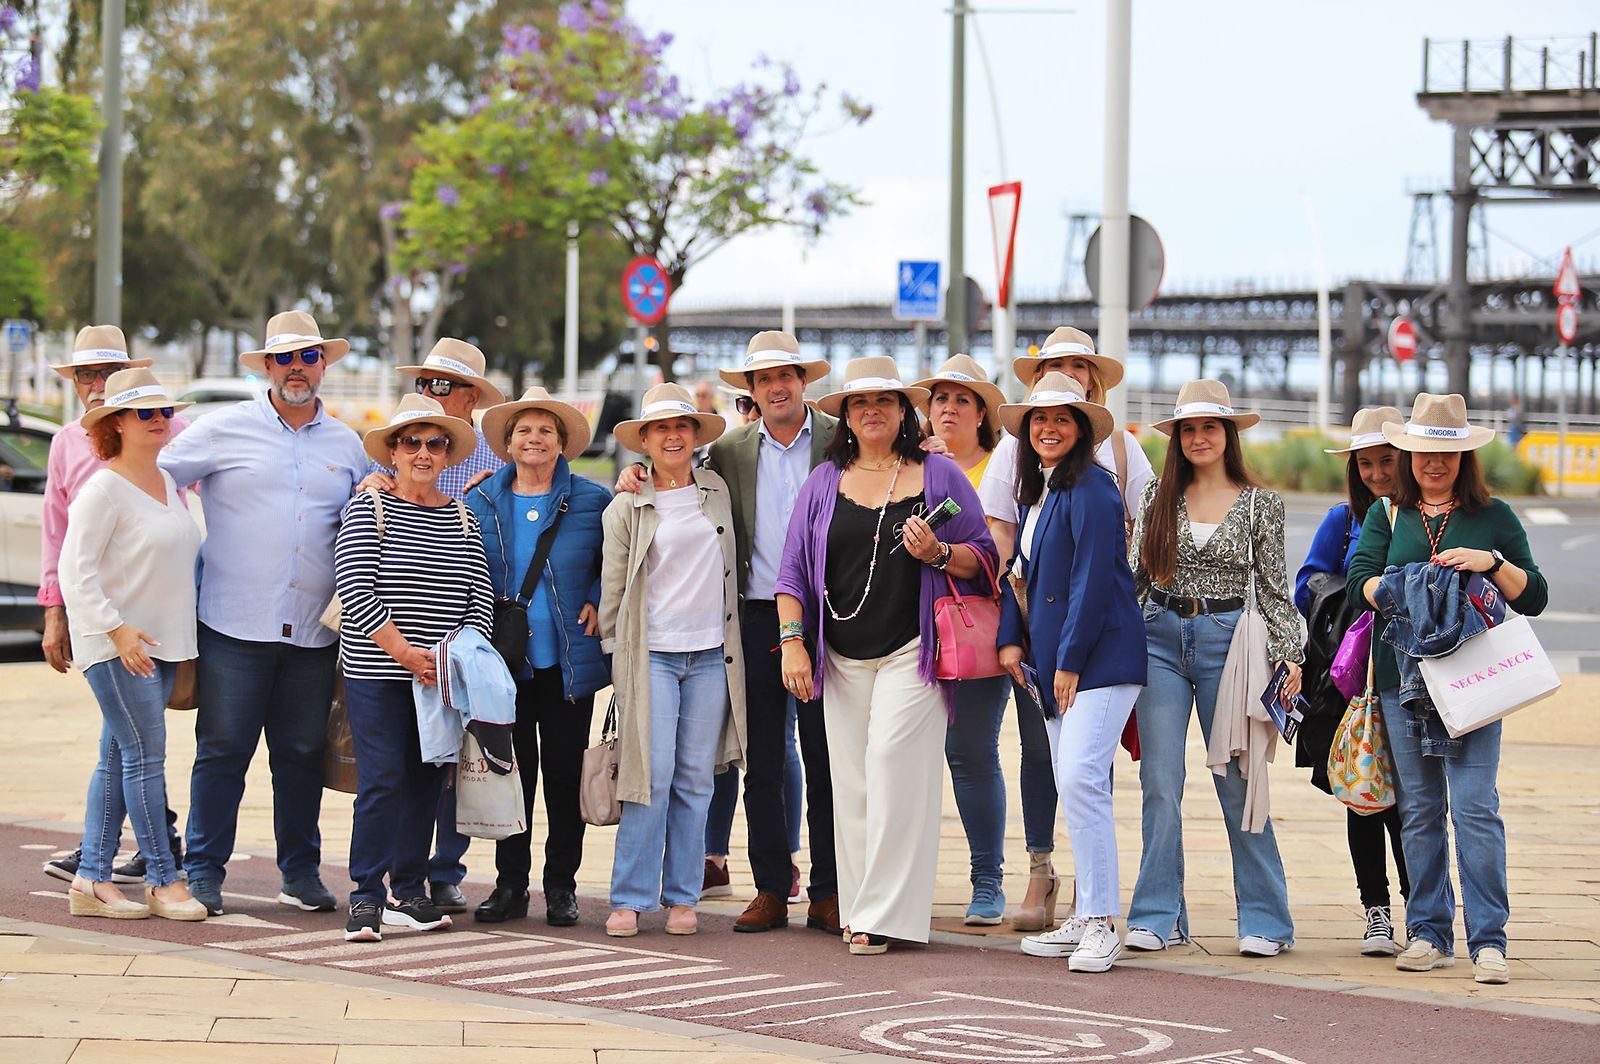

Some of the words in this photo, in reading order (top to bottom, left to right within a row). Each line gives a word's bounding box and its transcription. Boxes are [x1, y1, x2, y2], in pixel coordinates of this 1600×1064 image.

[111, 390, 140, 406] LONGORIA
[1424, 428, 1458, 438] LONGORIA
[1450, 671, 1486, 692] NECK
[1487, 666, 1498, 678] &
[1498, 649, 1535, 672] NECK
